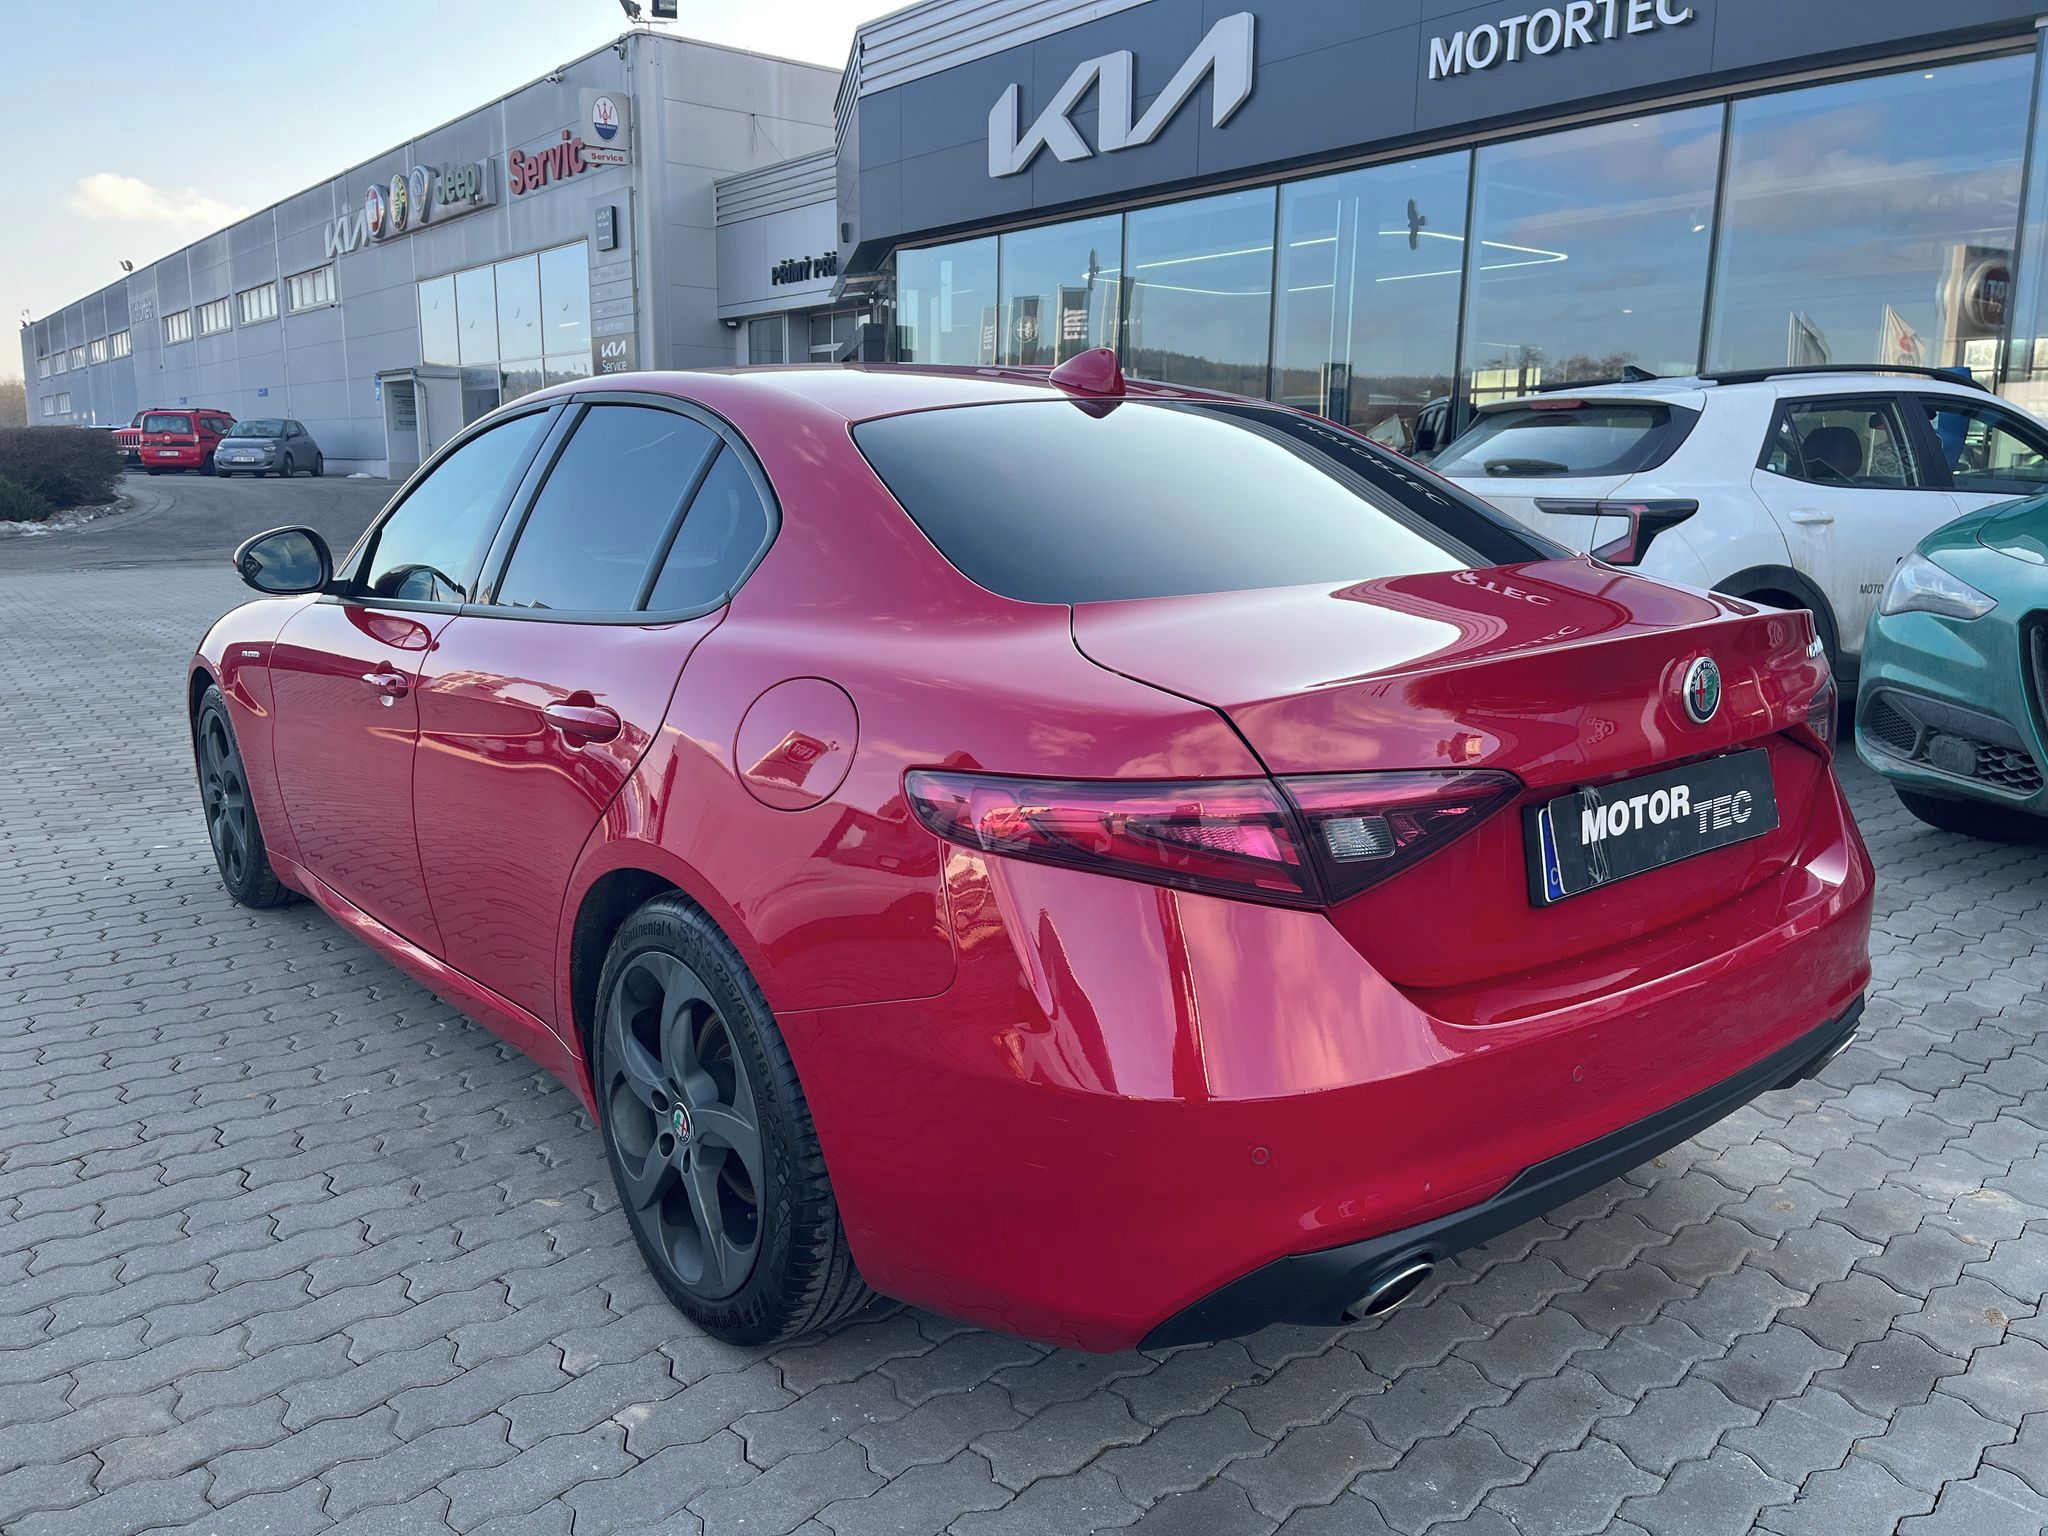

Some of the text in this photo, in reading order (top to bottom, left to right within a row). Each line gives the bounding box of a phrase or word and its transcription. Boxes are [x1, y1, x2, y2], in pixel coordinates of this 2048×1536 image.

[1428, 0, 1693, 80] MOTORTEC
[988, 11, 1255, 178] KIA
[509, 129, 602, 196] Servic
[591, 152, 624, 161] Service
[435, 162, 481, 205] Jeep
[324, 208, 371, 258] KIA
[601, 340, 626, 358] KIA
[602, 359, 627, 373] Service
[1581, 784, 1753, 846] MOTOR TEC
[621, 920, 666, 951] Continental
